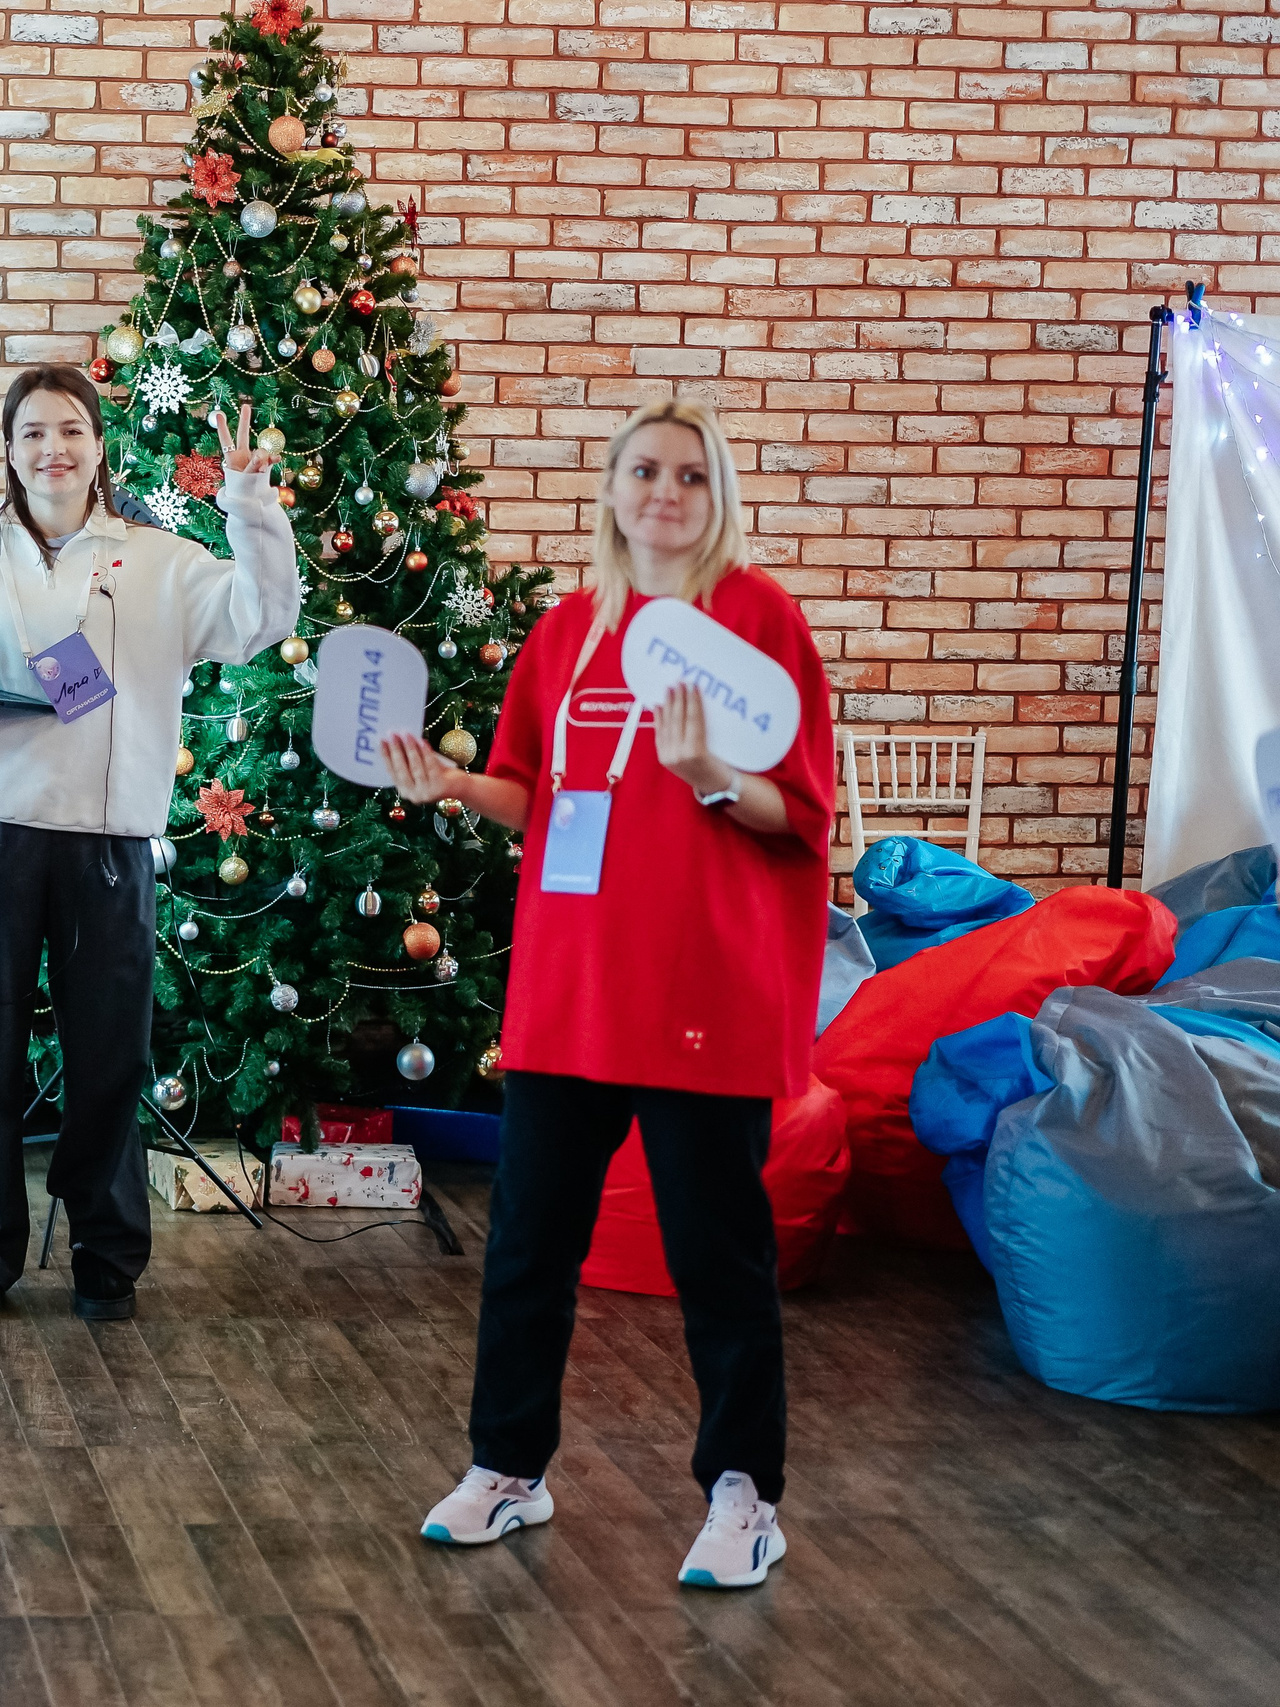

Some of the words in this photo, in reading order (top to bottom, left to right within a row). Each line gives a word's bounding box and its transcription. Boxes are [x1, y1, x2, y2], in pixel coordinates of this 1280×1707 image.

[363, 649, 384, 666] 4
[54, 675, 89, 704] Лера
[647, 636, 747, 720] ГРУППА
[752, 711, 772, 733] 4
[66, 688, 109, 716] ОРГАНИЗАТОР
[354, 670, 383, 766] ГРУППА
